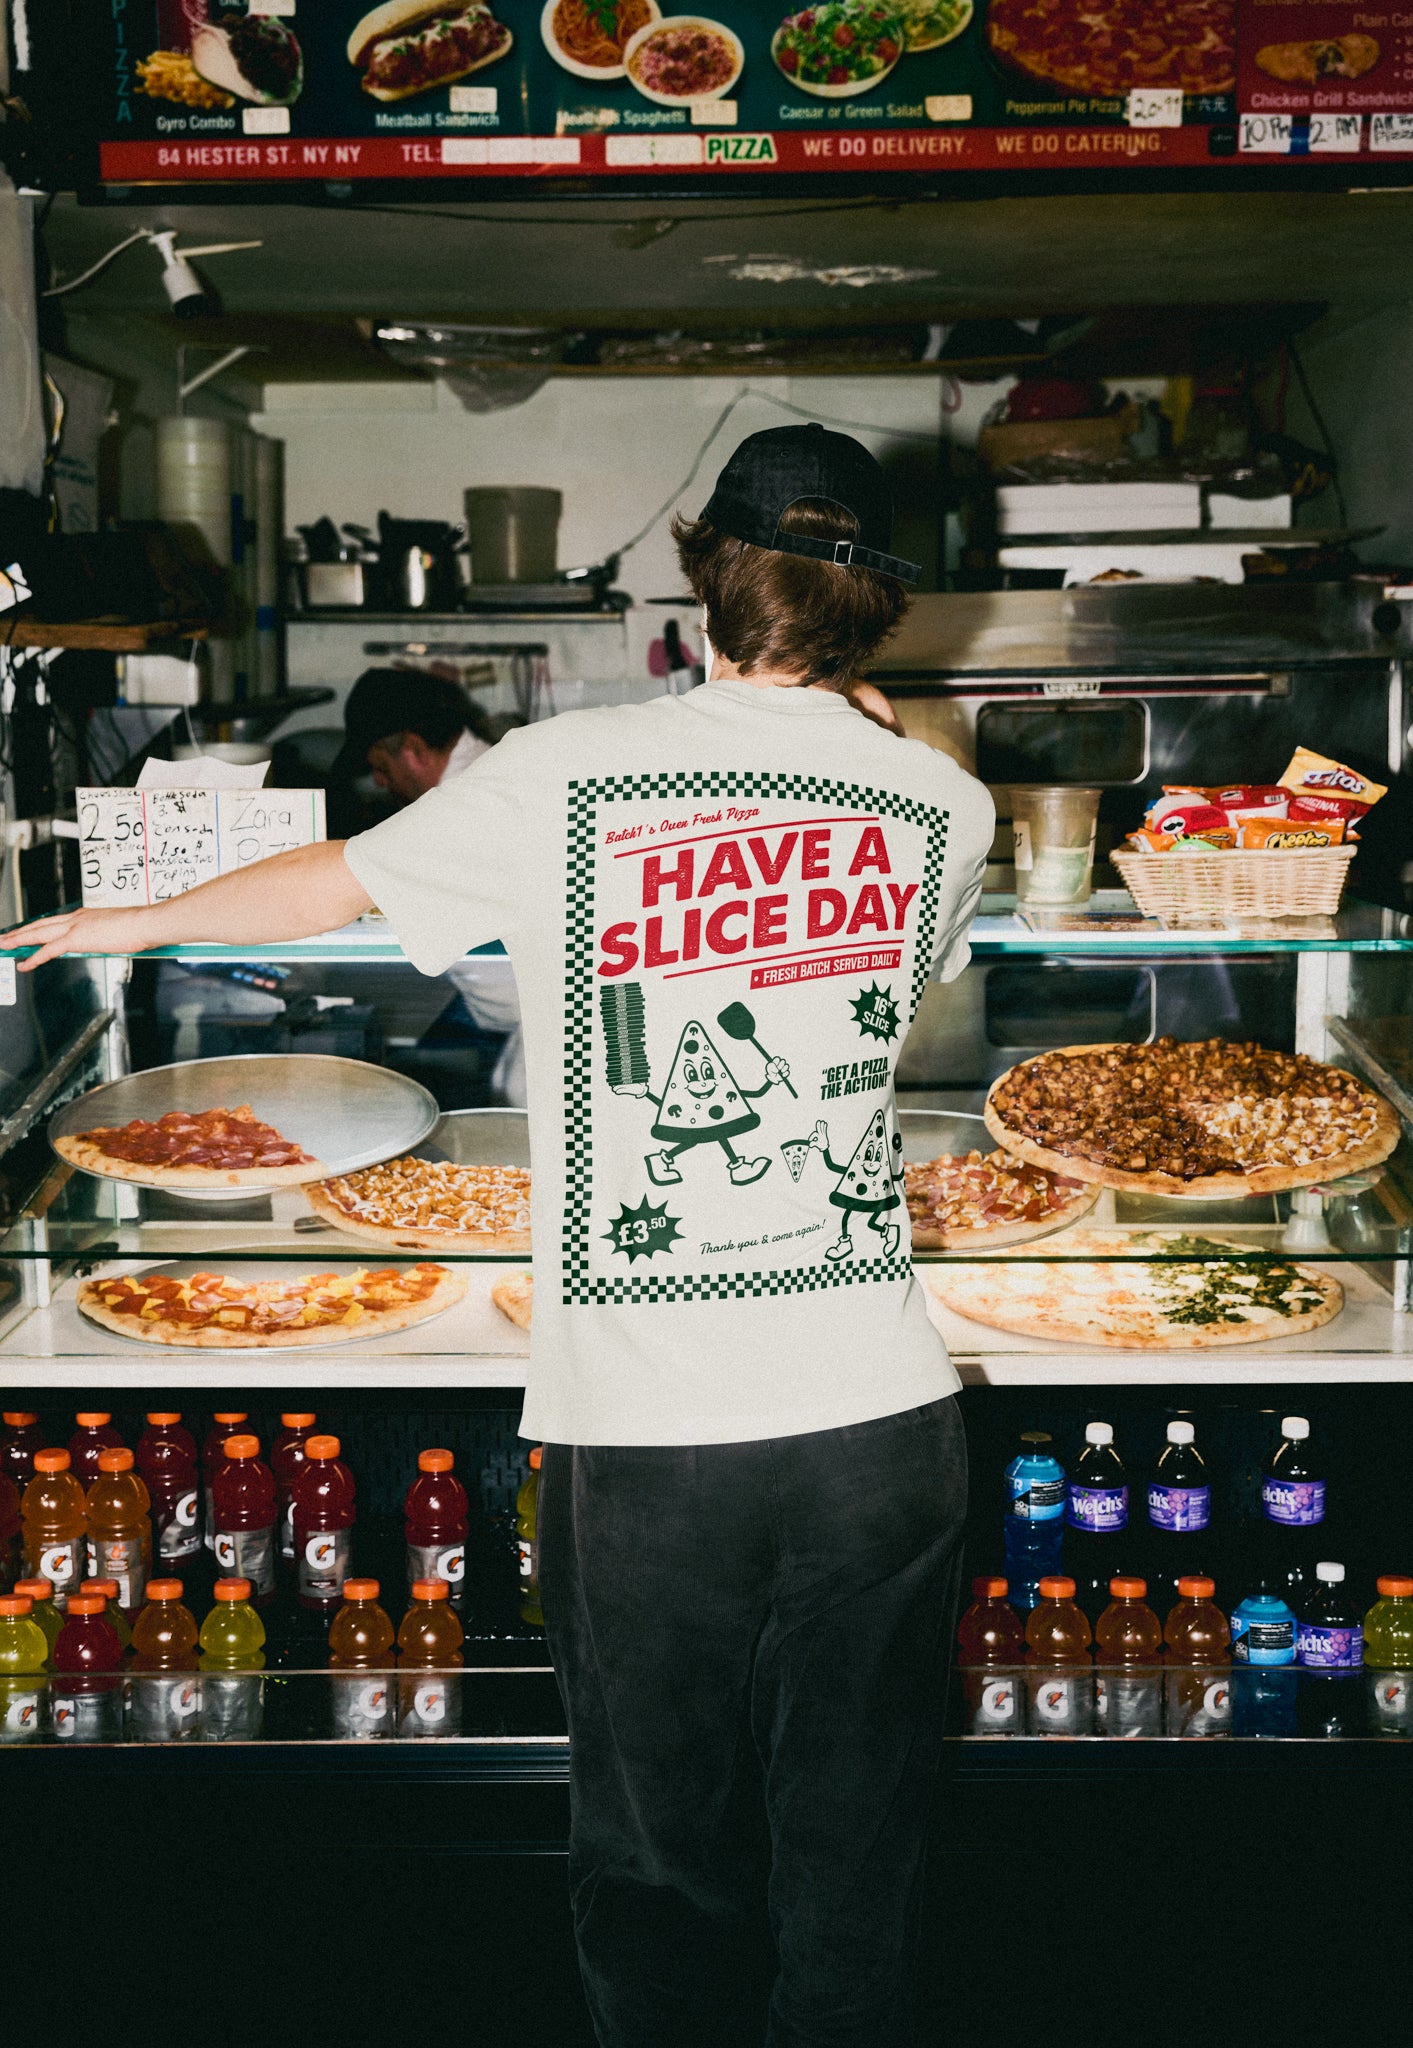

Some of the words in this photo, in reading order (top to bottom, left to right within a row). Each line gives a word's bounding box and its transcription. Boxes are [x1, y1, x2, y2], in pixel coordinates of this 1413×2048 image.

[779, 104, 823, 119] Caesar
[827, 106, 841, 119] or
[845, 103, 884, 119] Green
[886, 103, 923, 118] Salad
[1006, 100, 1064, 116] Pepperoni
[1068, 99, 1087, 114] Pie
[1090, 98, 1122, 113] Pizza
[1251, 93, 1310, 109] Chicken
[1313, 91, 1344, 108] Grill
[156, 115, 187, 133] Gyro
[189, 114, 236, 131] Combo
[435, 112, 500, 128] Sandwich
[623, 110, 686, 128] Spaghetti
[996, 135, 1027, 154] WE
[1031, 134, 1059, 153] DO
[1241, 117, 1267, 149] 10
[158, 147, 181, 166] 84
[186, 146, 260, 165] HESTER
[303, 144, 329, 164] NY
[334, 144, 362, 163] NY
[707, 137, 774, 160] PIZZA
[803, 138, 834, 157] WE
[838, 137, 867, 156] DO
[229, 798, 292, 832] Zara
[659, 819, 688, 832] Oven
[692, 810, 723, 826] Fresh
[727, 807, 760, 821] Pizza
[642, 829, 832, 908] HAVE
[848, 826, 892, 876] A
[597, 893, 788, 977] SLICE
[807, 884, 920, 939] DAY
[763, 965, 798, 984] FRESH
[800, 961, 830, 978] BATCH
[833, 955, 868, 972] SERVED
[871, 953, 895, 967] DAILY
[862, 1010, 890, 1033] SLICE
[850, 1062, 859, 1078] A
[861, 1056, 888, 1076] PIZZA
[820, 1081, 844, 1100] THE
[700, 1240, 736, 1255] Thank
[737, 1238, 759, 1254] you
[761, 1235, 769, 1245] &
[772, 1231, 793, 1243] come
[795, 1218, 827, 1240] again!
[1072, 1495, 1124, 1515] Welch's
[40, 1545, 74, 1580] G
[305, 1535, 335, 1570] G
[437, 1546, 464, 1582] G
[414, 1684, 446, 1722] G
[982, 1681, 1014, 1719] G
[1036, 1680, 1068, 1719] G
[1374, 1678, 1406, 1714] G
